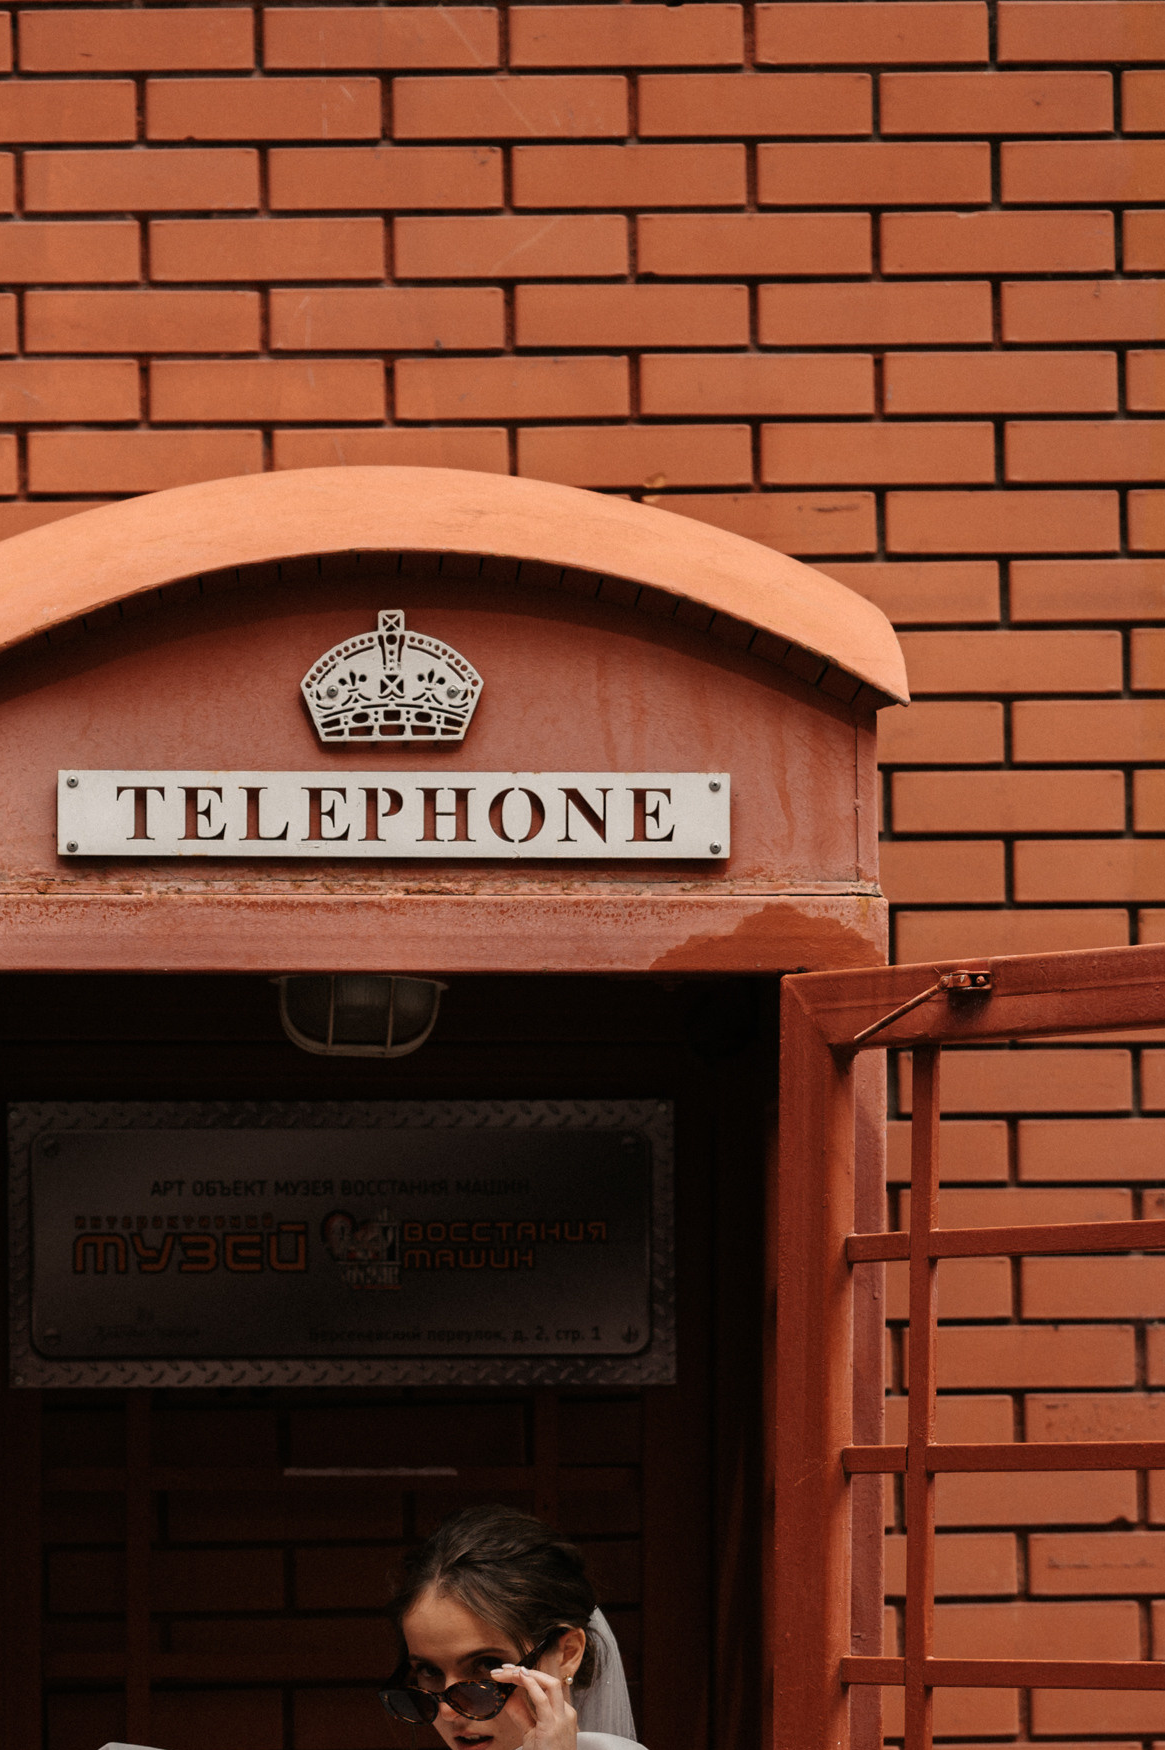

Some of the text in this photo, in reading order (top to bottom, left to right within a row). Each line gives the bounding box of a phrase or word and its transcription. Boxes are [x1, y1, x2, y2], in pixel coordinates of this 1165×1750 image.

[116, 784, 676, 844] TELEPHONE
[150, 1180, 185, 1196] АРТ
[192, 1180, 267, 1196] ОБЪЕКТ
[274, 1180, 334, 1196] МУЗЕЯ
[341, 1179, 449, 1196] ВОССТАНИЯ
[402, 1220, 608, 1243] ВОССТАНИЯ
[591, 1325, 601, 1340] 1
